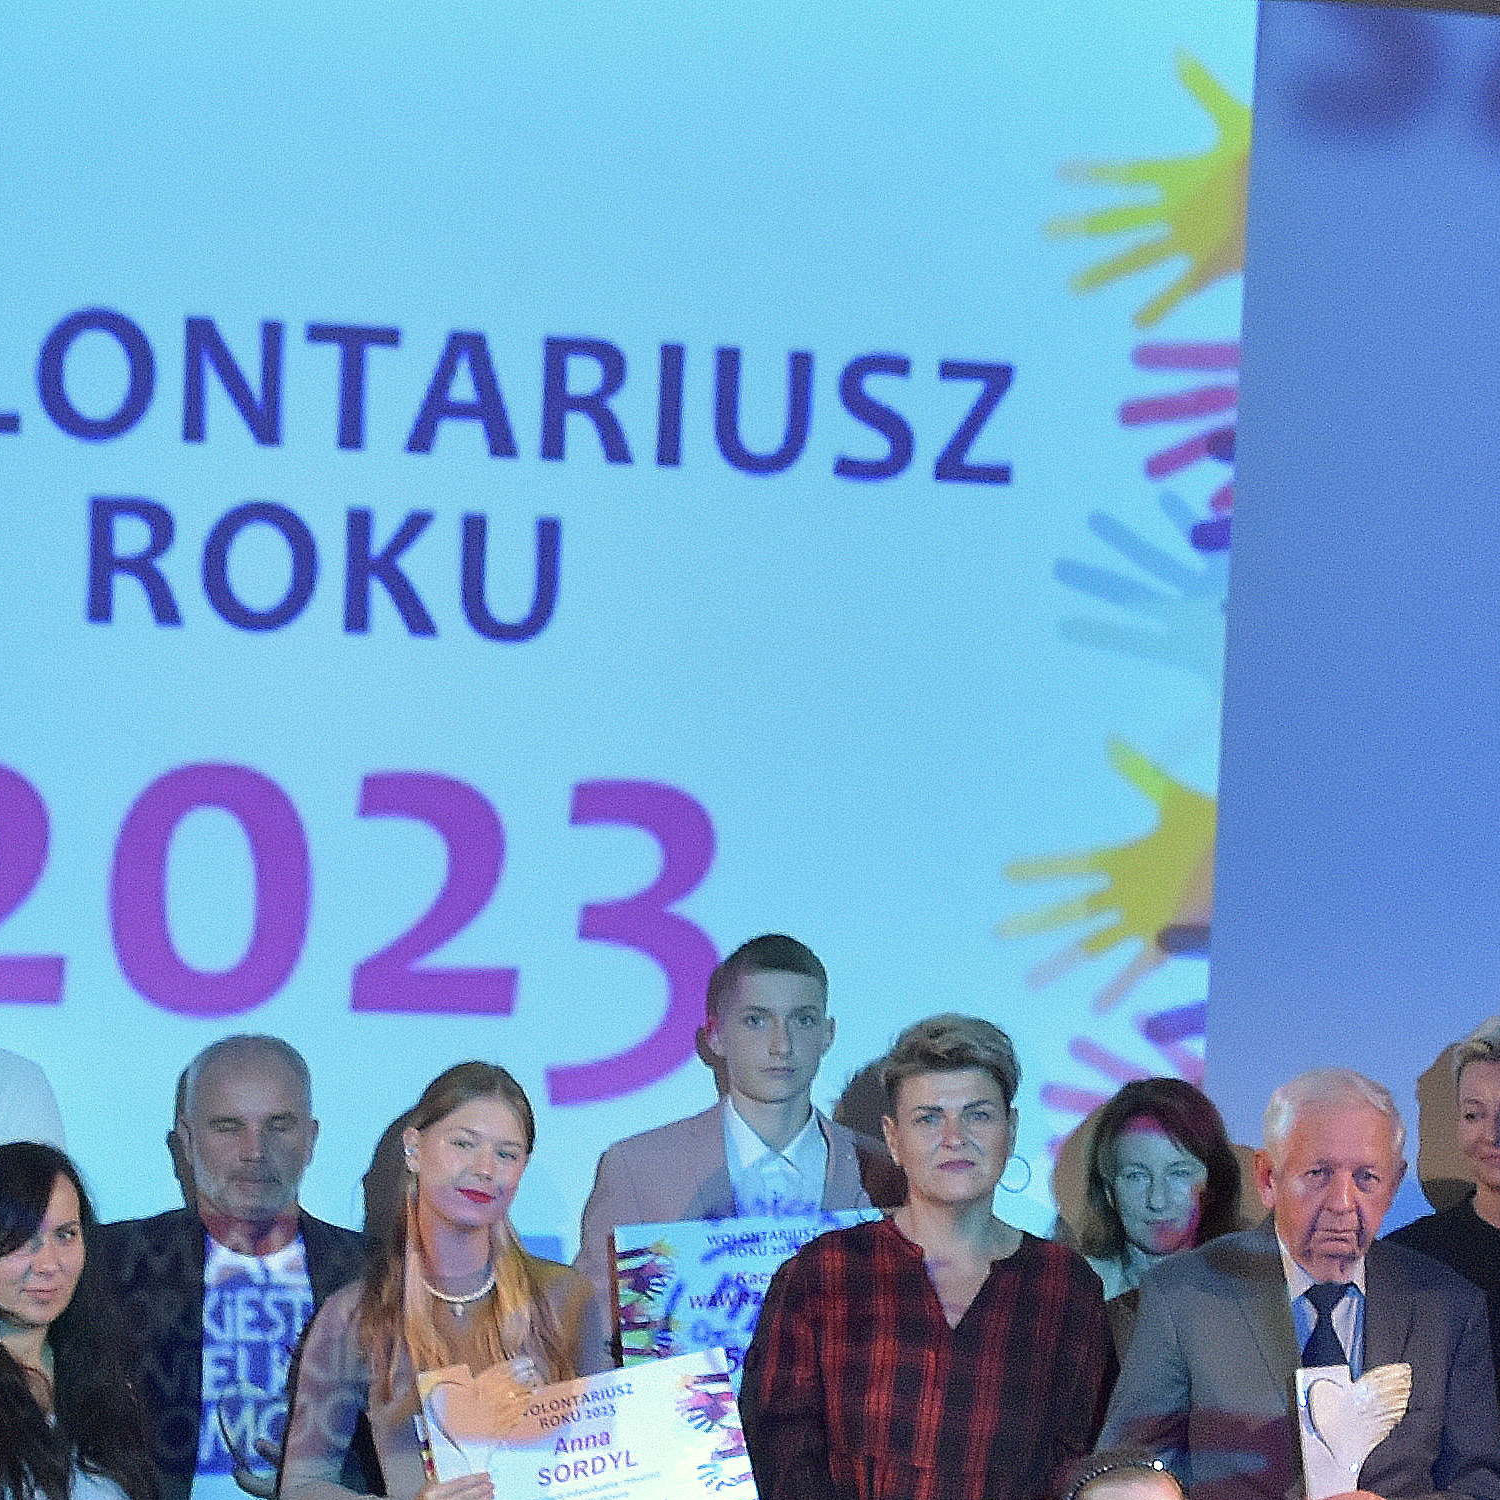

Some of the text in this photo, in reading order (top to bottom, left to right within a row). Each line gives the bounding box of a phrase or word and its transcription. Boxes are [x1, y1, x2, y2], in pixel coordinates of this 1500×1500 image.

[84, 494, 562, 643] ROKU
[706, 1226, 819, 1246] WOLONTARIUSZ
[735, 1271, 771, 1285] Kac
[522, 1383, 634, 1418] OLONTARIUSZ
[539, 1404, 616, 1430] ROKU 2023
[554, 1430, 611, 1456] Anna
[537, 1449, 638, 1487] SORDYL
